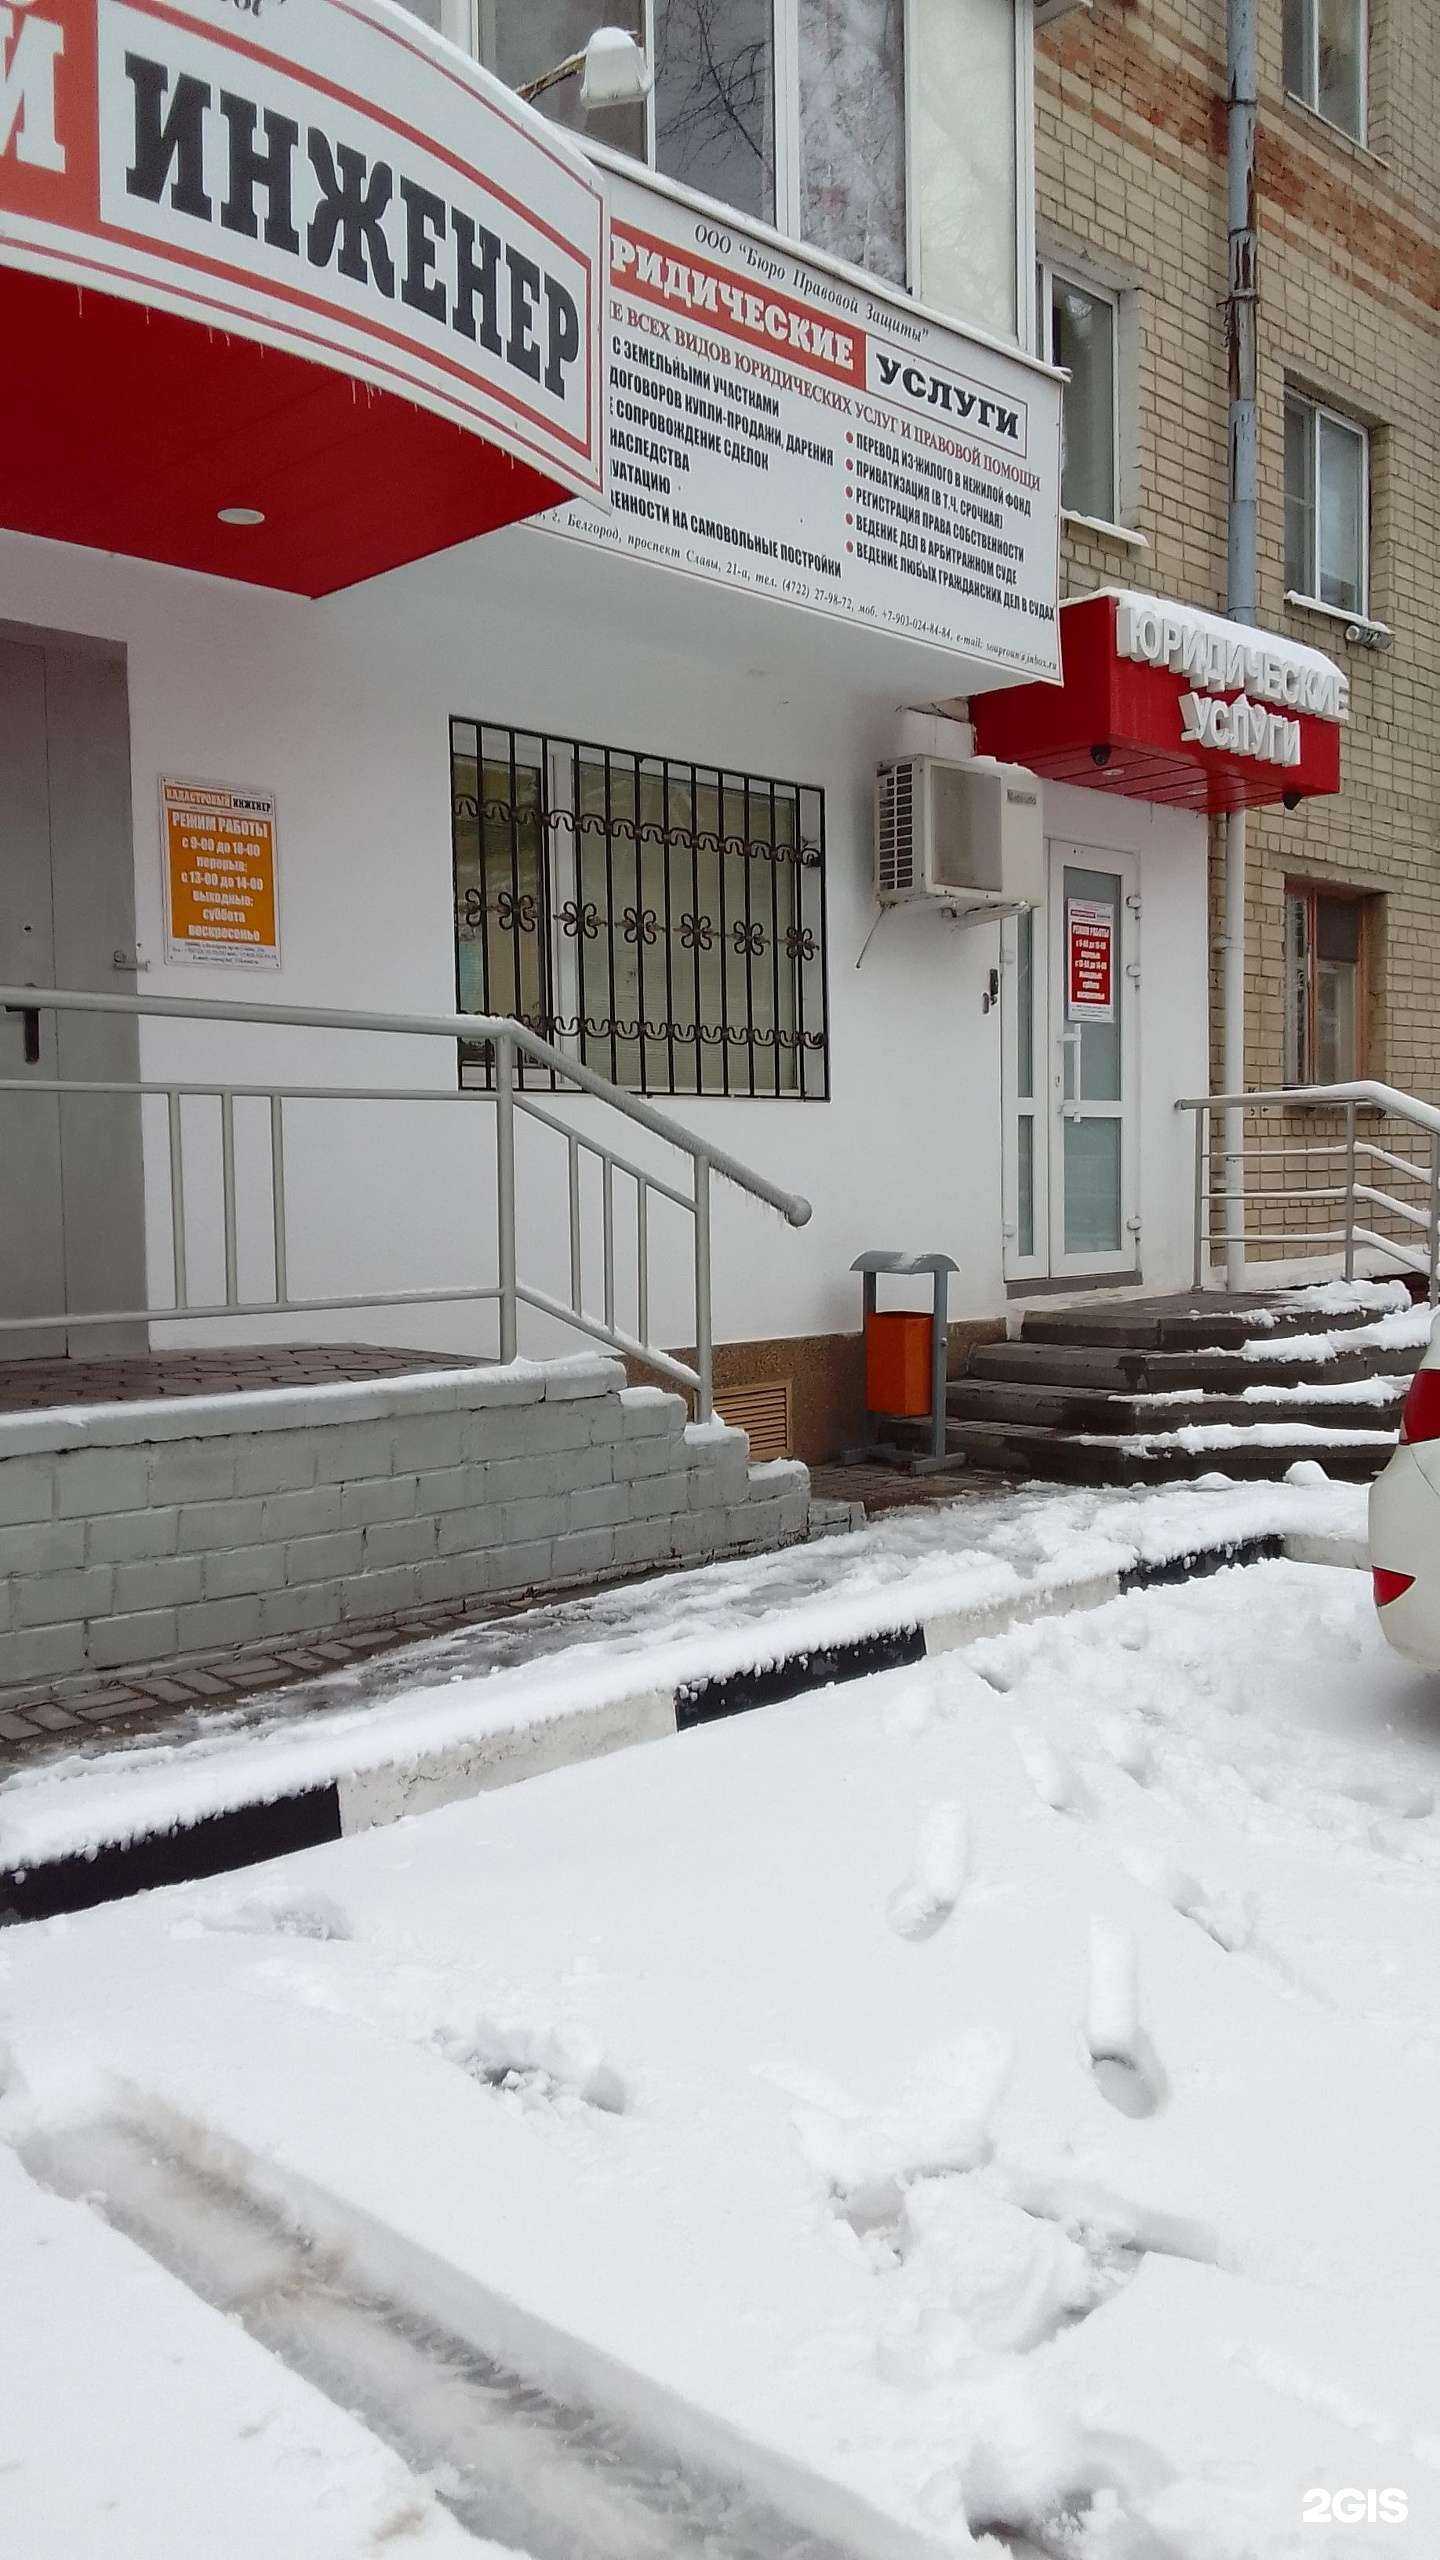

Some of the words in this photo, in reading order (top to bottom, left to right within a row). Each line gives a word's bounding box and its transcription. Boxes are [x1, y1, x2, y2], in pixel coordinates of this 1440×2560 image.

[124, 50, 579, 400] ИНЖЕНЕР
[694, 223, 732, 254] ООО
[791, 269, 859, 315] Правовой
[610, 233, 854, 370] РИДИЧЕСКИЕ
[875, 353, 1019, 440] УСЛУГИ
[612, 335, 621, 355] С
[623, 340, 711, 390] ЗЕМЕЛЬНЫМИ
[713, 375, 780, 418] УЧАСТКАМИ
[627, 307, 671, 343] ВСЕХ
[674, 327, 732, 364] ВИДОВ
[733, 351, 853, 416] ЮРИДИЧЕСКИХ
[854, 401, 898, 434] УСЛУГ
[900, 419, 912, 437] И
[914, 426, 982, 466] ПРАВОВОЙ
[983, 456, 1041, 493] ПОМОЩИ
[609, 427, 690, 472] НАСЛЕДСТВА
[610, 365, 683, 410] ДОГОВОРОВ
[685, 392, 784, 450] КУПЛИ-ПРОДАЖИ,
[785, 433, 834, 467] ДАРЕНИЯ
[616, 399, 722, 454] СОПРОВОЖДЕНИЕ
[723, 438, 769, 471] СДЕЛОК
[611, 458, 671, 495] УАТАЦИЮ
[856, 433, 900, 465] ПЕРЕВОД
[901, 451, 915, 471] ИЗ
[915, 456, 953, 484] ЖИЛОГО
[954, 469, 961, 487] В
[962, 473, 1004, 504] НЕЖИЛОЙ
[1004, 487, 1032, 518] ФОНД
[856, 459, 930, 502] ПРИВАТИЗАЦИЯ
[931, 487, 942, 506] (В
[942, 490, 959, 514] Т.Ч.
[959, 497, 1004, 529] СРОЧНАЯ)
[672, 508, 688, 531] НА
[690, 514, 779, 560] САМОВОЛЬНЫЕ
[780, 543, 842, 579] ПОСТРОЙКИ
[855, 486, 921, 526] РЕГИСТРАЦИЯ
[921, 510, 951, 536] ПРАВА
[952, 522, 1025, 563] СОБСТВЕННОСТИ
[856, 514, 898, 544] ВЕДЕНИЕ
[899, 533, 919, 553] ДЕЛ
[920, 539, 927, 555] В
[927, 542, 994, 577] АРБИТРАЖНОМ
[995, 565, 1017, 586] СУДЕ
[567, 512, 622, 544] Белгород,
[627, 533, 681, 559] проспект
[686, 549, 721, 573] Славы,
[755, 572, 777, 588] тел.
[782, 578, 810, 599] (4722)
[858, 604, 878, 618] моб.
[856, 542, 898, 571] ВЕДЕНИЕ
[899, 556, 937, 583] ЛЮБЫХ
[938, 569, 1002, 603] ГРАЖДАНСКИХ
[1002, 592, 1020, 612] ДЕЛ
[1021, 601, 1027, 613] В
[1028, 602, 1055, 622] СУДАХ
[1116, 605, 1349, 721] ЮРИДИЧЕСКИЕ
[1178, 692, 1301, 768] УСЛУГИ
[172, 811, 217, 832] РЕЖИМ
[218, 814, 268, 838] РАБОТЫ
[232, 798, 271, 812] ИНЖЕНЕР
[190, 836, 215, 851] 9-00
[216, 842, 230, 855] до
[219, 876, 234, 890] до
[202, 907, 246, 923] суббота
